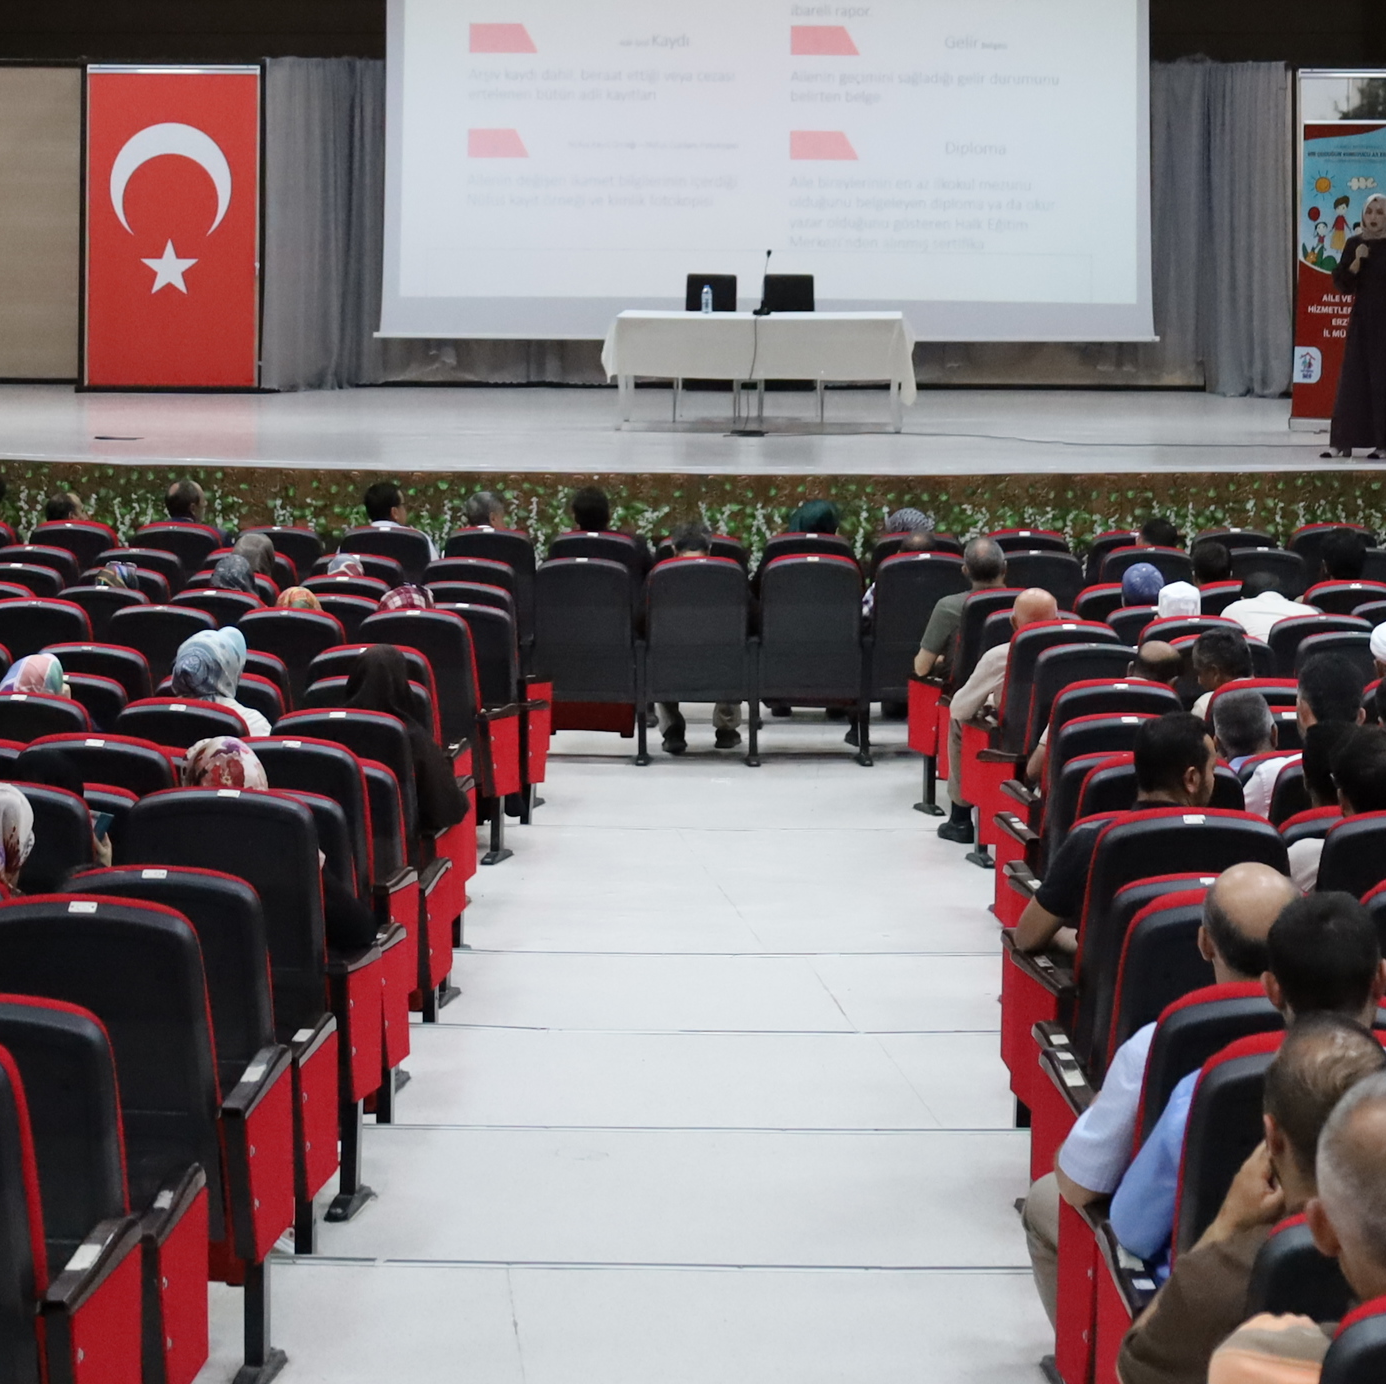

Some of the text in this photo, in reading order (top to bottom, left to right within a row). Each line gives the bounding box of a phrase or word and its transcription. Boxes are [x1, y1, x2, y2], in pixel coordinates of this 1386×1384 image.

[652, 34, 690, 50] Kaydı
[944, 35, 980, 50] Gelir
[945, 141, 1006, 156] Diploma
[1322, 294, 1352, 303] AİLE VE
[1331, 318, 1350, 326] ERZ
[1323, 328, 1330, 337] İL
